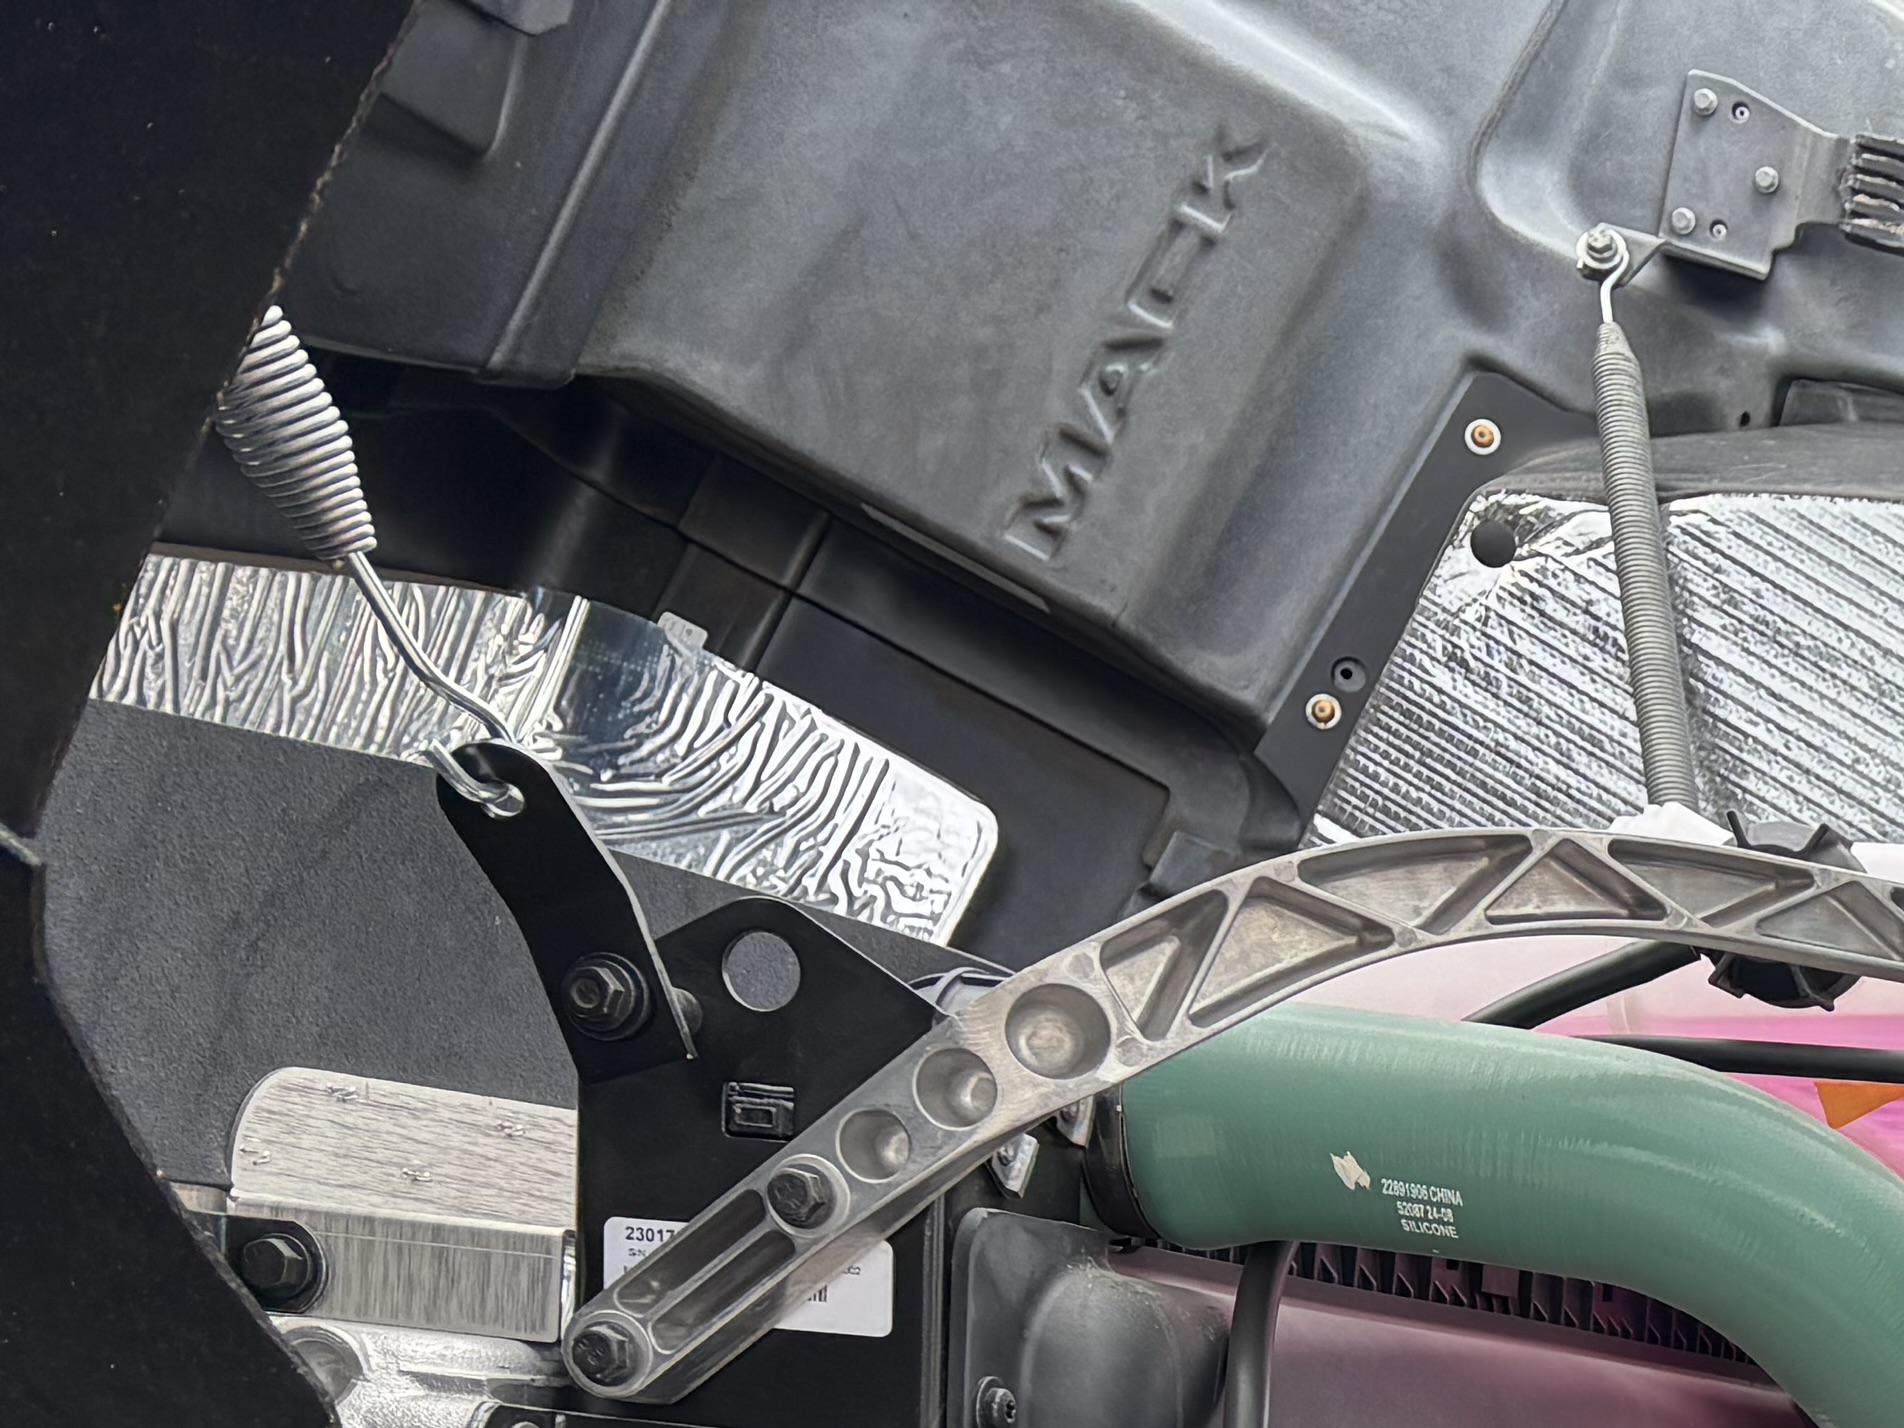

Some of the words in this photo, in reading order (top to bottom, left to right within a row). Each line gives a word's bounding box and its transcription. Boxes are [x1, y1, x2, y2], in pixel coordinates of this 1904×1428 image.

[1002, 128, 1268, 559] MACK
[1429, 1186, 1463, 1207] CHINA
[1401, 1219, 1459, 1239] SILICONE
